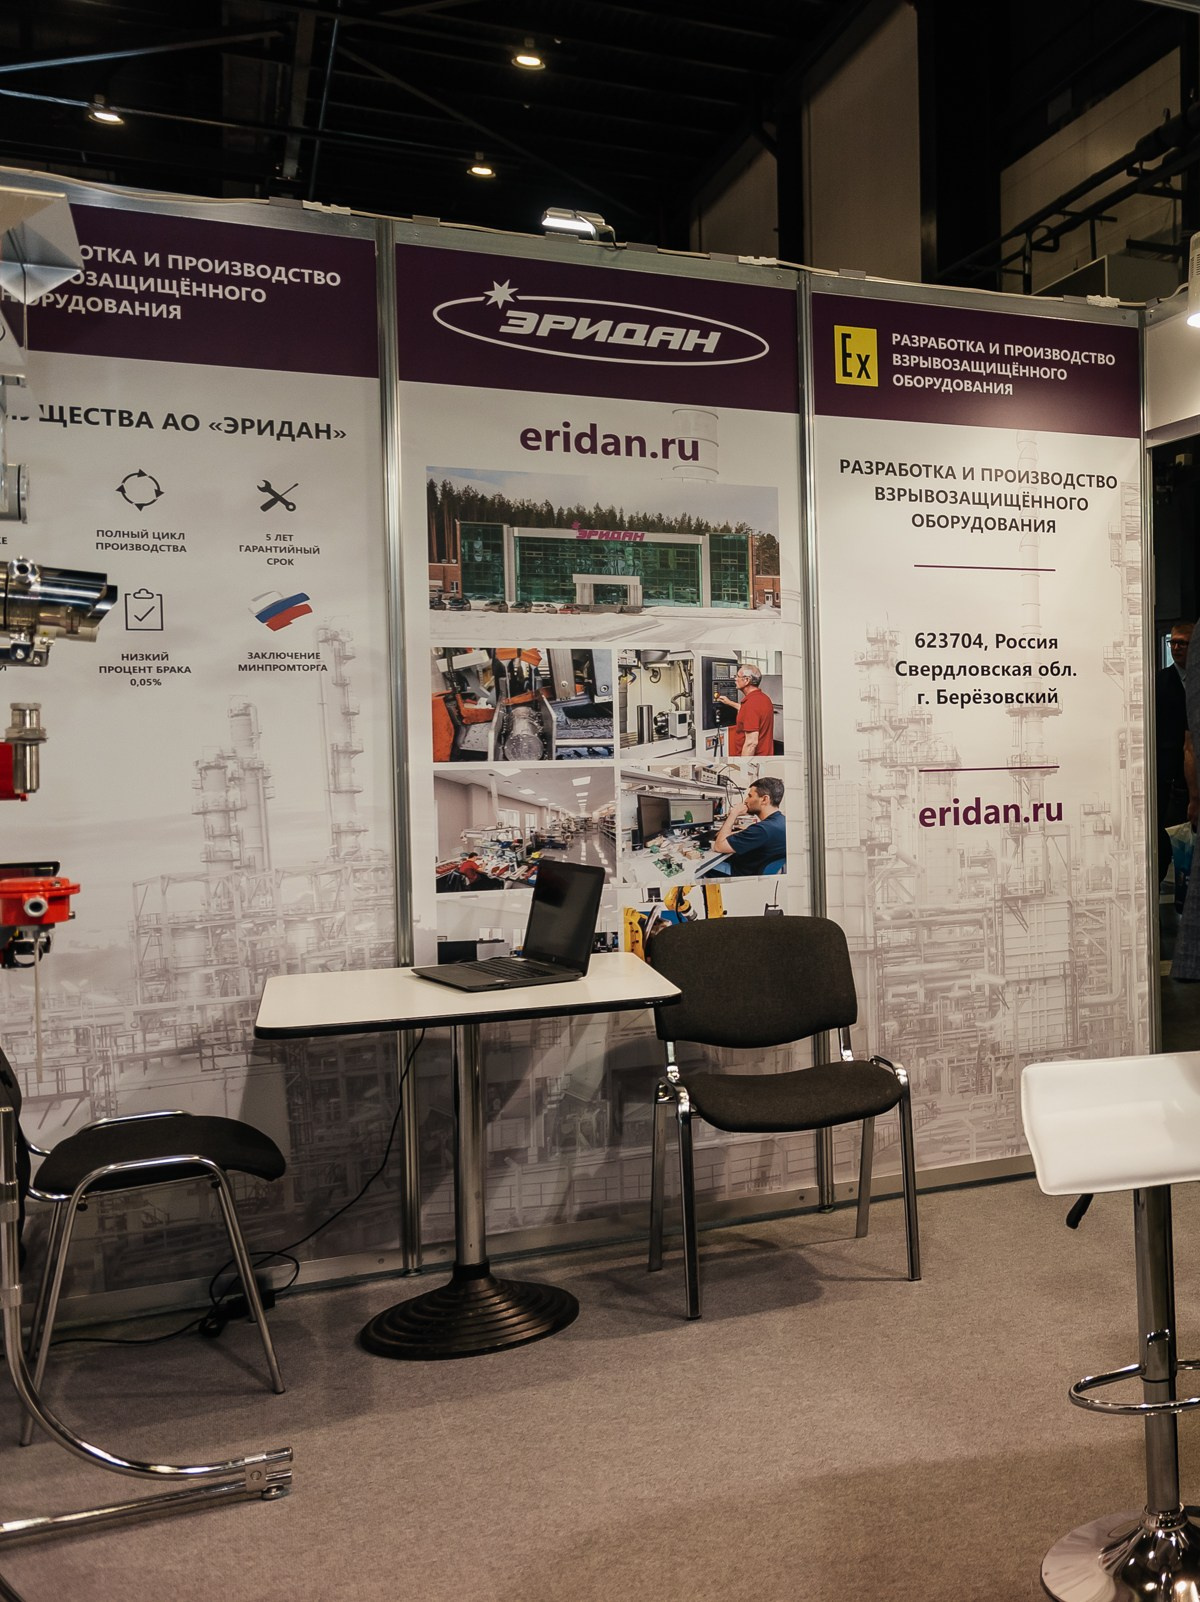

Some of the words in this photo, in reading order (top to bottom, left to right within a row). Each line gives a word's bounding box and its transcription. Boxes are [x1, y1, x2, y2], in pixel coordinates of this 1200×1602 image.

[144, 252, 161, 268] И
[167, 254, 342, 287] ПРОИЗВОДСТВО
[68, 270, 267, 303] ОЗАЩИЩЁННОГО
[28, 292, 182, 320] РУДОВАНИЯ
[499, 309, 722, 354] ЭРИДАН
[841, 332, 871, 380] Ex
[891, 332, 985, 355] РАЗРАБОТКА
[989, 342, 1000, 355] И
[1004, 343, 1116, 366] ПРОИЗВОДСТВО
[892, 353, 1068, 381] ВЗРЫВОЗАЩИЩЁННОГО
[892, 374, 1014, 396] ОБОРУДОВАНИЯ
[36, 403, 154, 430] ЩЕСТВА
[162, 412, 200, 432] АО
[208, 416, 347, 442] «ЭРИДАН»
[519, 421, 700, 462] eridan.ru
[839, 458, 956, 481] РАЗРАБОТКА
[962, 466, 976, 481] И
[980, 467, 1118, 490] ПРОИЗВОДСТВО
[874, 485, 1089, 512] ВЗРЫВОЗАЩИЩЁННОГО
[911, 513, 1057, 534] ОБОРУДОВАНИЯ
[96, 528, 149, 541] ПОЛНЫЙ
[152, 531, 186, 542] ЦИКЛ
[265, 533, 272, 542] 5
[274, 533, 295, 543] ЛЕТ
[576, 528, 646, 541] ЭРИДАН
[95, 542, 187, 554] ПРОИЗВОДСТВА
[239, 544, 321, 555] ГАРАНТИЙНЫЙ
[266, 557, 295, 567] СРОК
[914, 631, 989, 651] 623704,
[994, 633, 1059, 650] Россия
[121, 651, 170, 662] НИЗКИЙ
[247, 651, 321, 661] ЗАКЛЮЧЕНИЕ
[99, 665, 154, 676] ПРОЦЕНТ
[155, 665, 192, 675] БРАКА
[238, 663, 329, 674] МИНПРОМТОРГА
[894, 660, 1033, 681] Свердловская
[1038, 660, 1078, 678] обл.
[130, 678, 162, 688] 0,05%
[916, 692, 930, 706] г.
[936, 687, 1059, 709] Берёзовский
[918, 796, 1064, 828] eridan.ru
